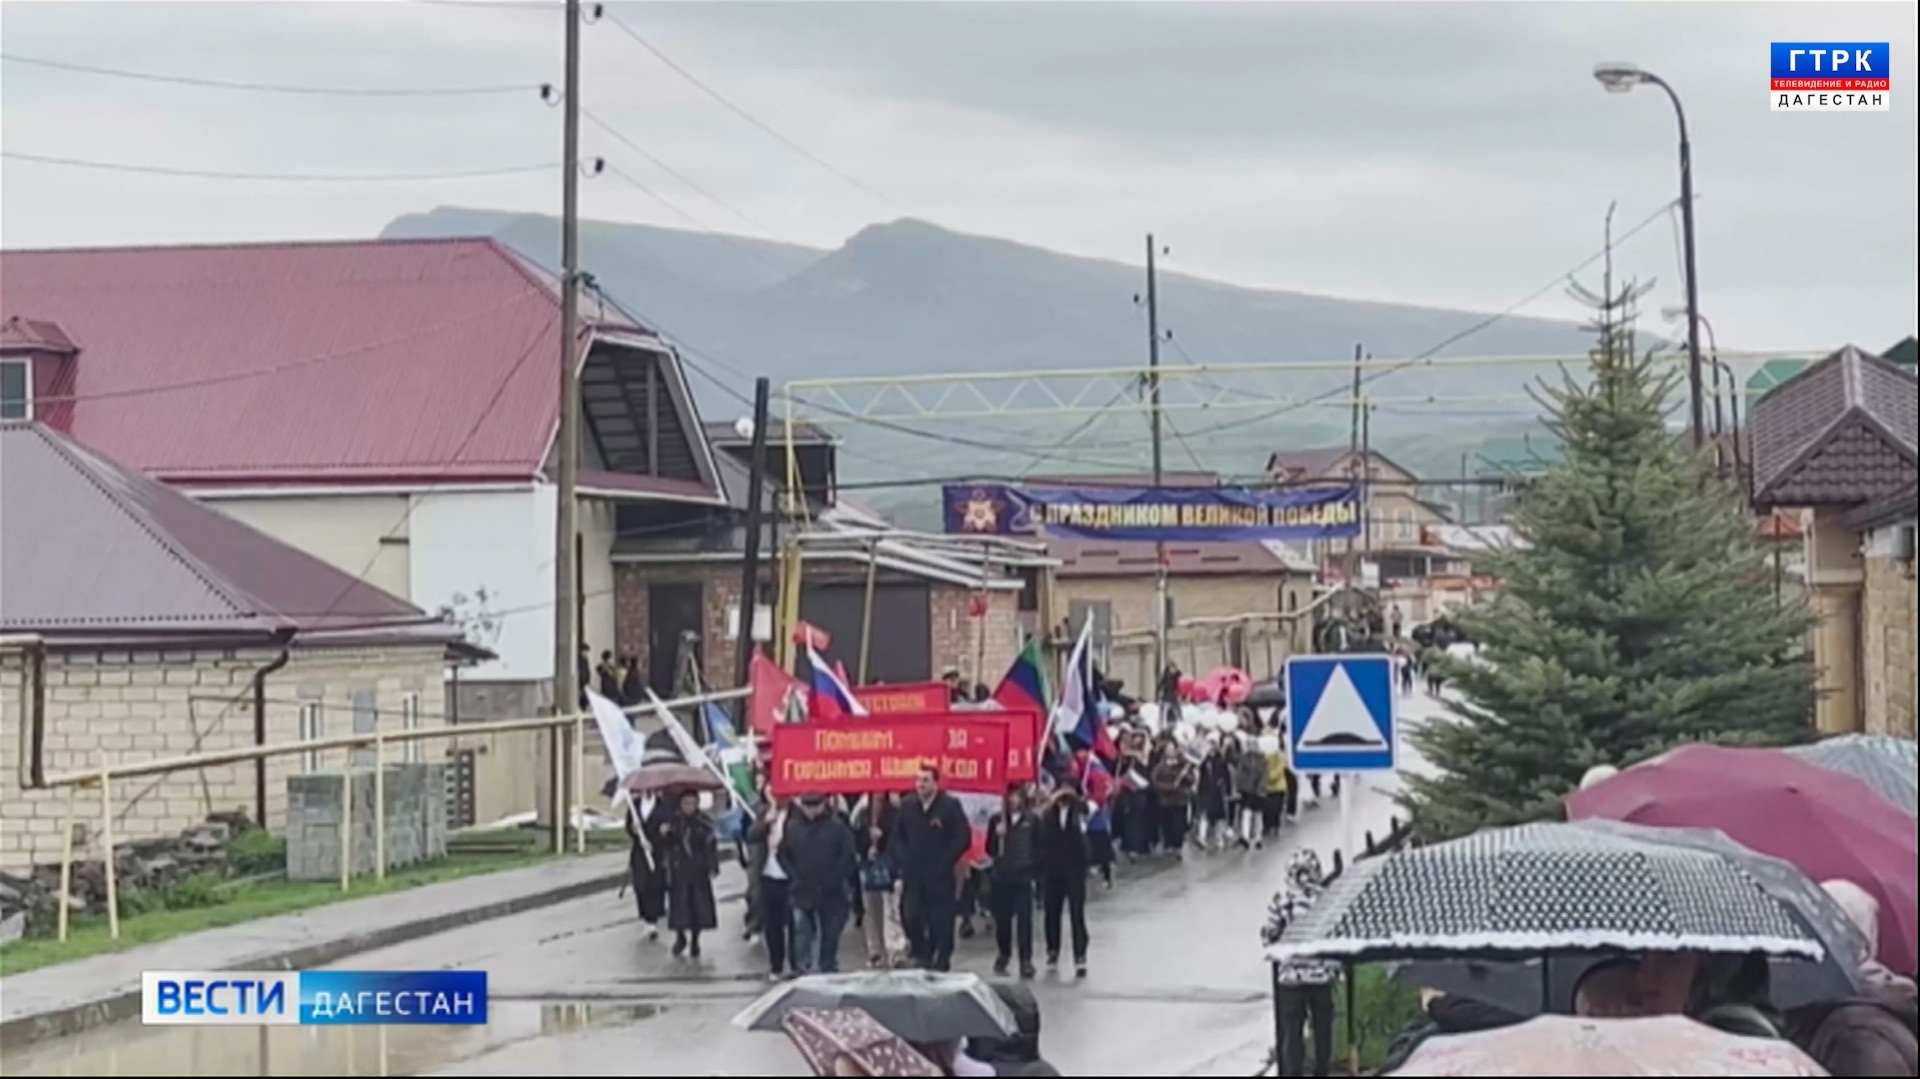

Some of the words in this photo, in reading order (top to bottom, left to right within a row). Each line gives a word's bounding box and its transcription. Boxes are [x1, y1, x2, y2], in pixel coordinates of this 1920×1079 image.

[1046, 502, 1178, 529] ПРАЗДНИКОМ
[1182, 502, 1268, 527] ВЕЛИКОЙ
[1273, 501, 1356, 527] ПОБЕДЫ
